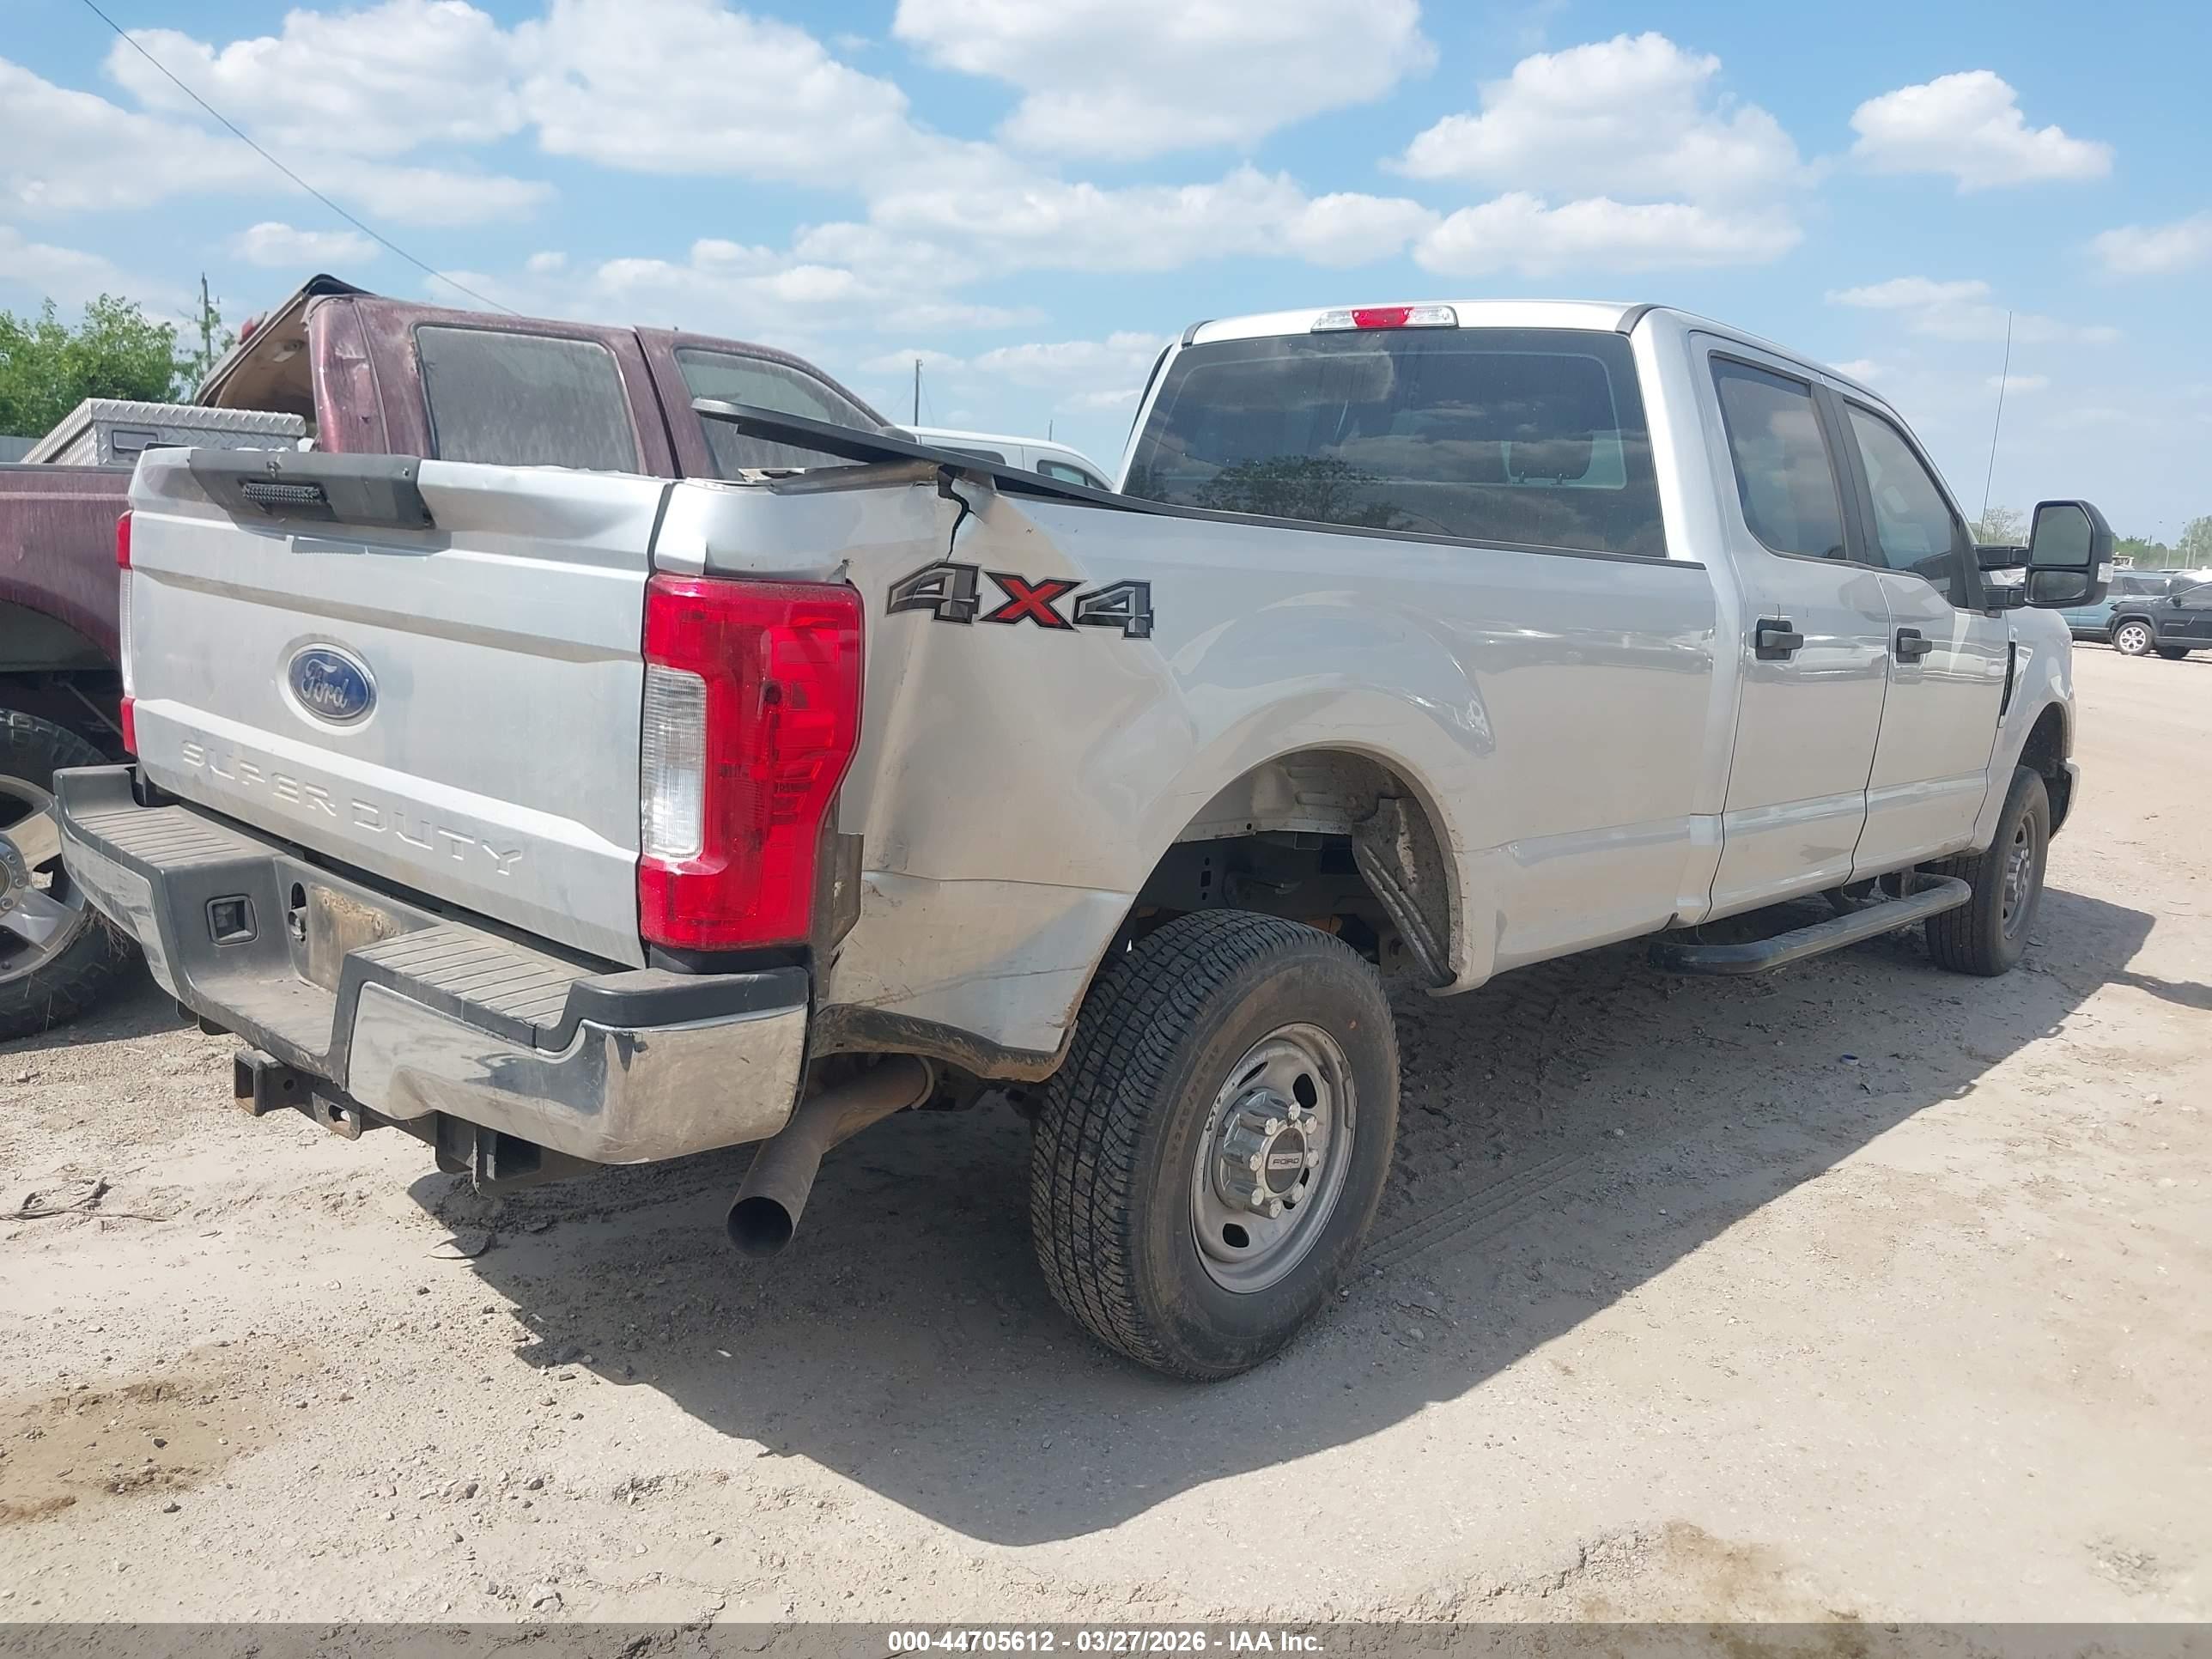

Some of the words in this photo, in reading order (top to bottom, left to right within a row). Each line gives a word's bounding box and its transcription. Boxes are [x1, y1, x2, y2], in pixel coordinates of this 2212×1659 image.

[302, 659, 348, 708] Ford
[182, 740, 337, 817] SUPER
[351, 799, 523, 876] DUTY
[1271, 1157, 1300, 1166] FORD
